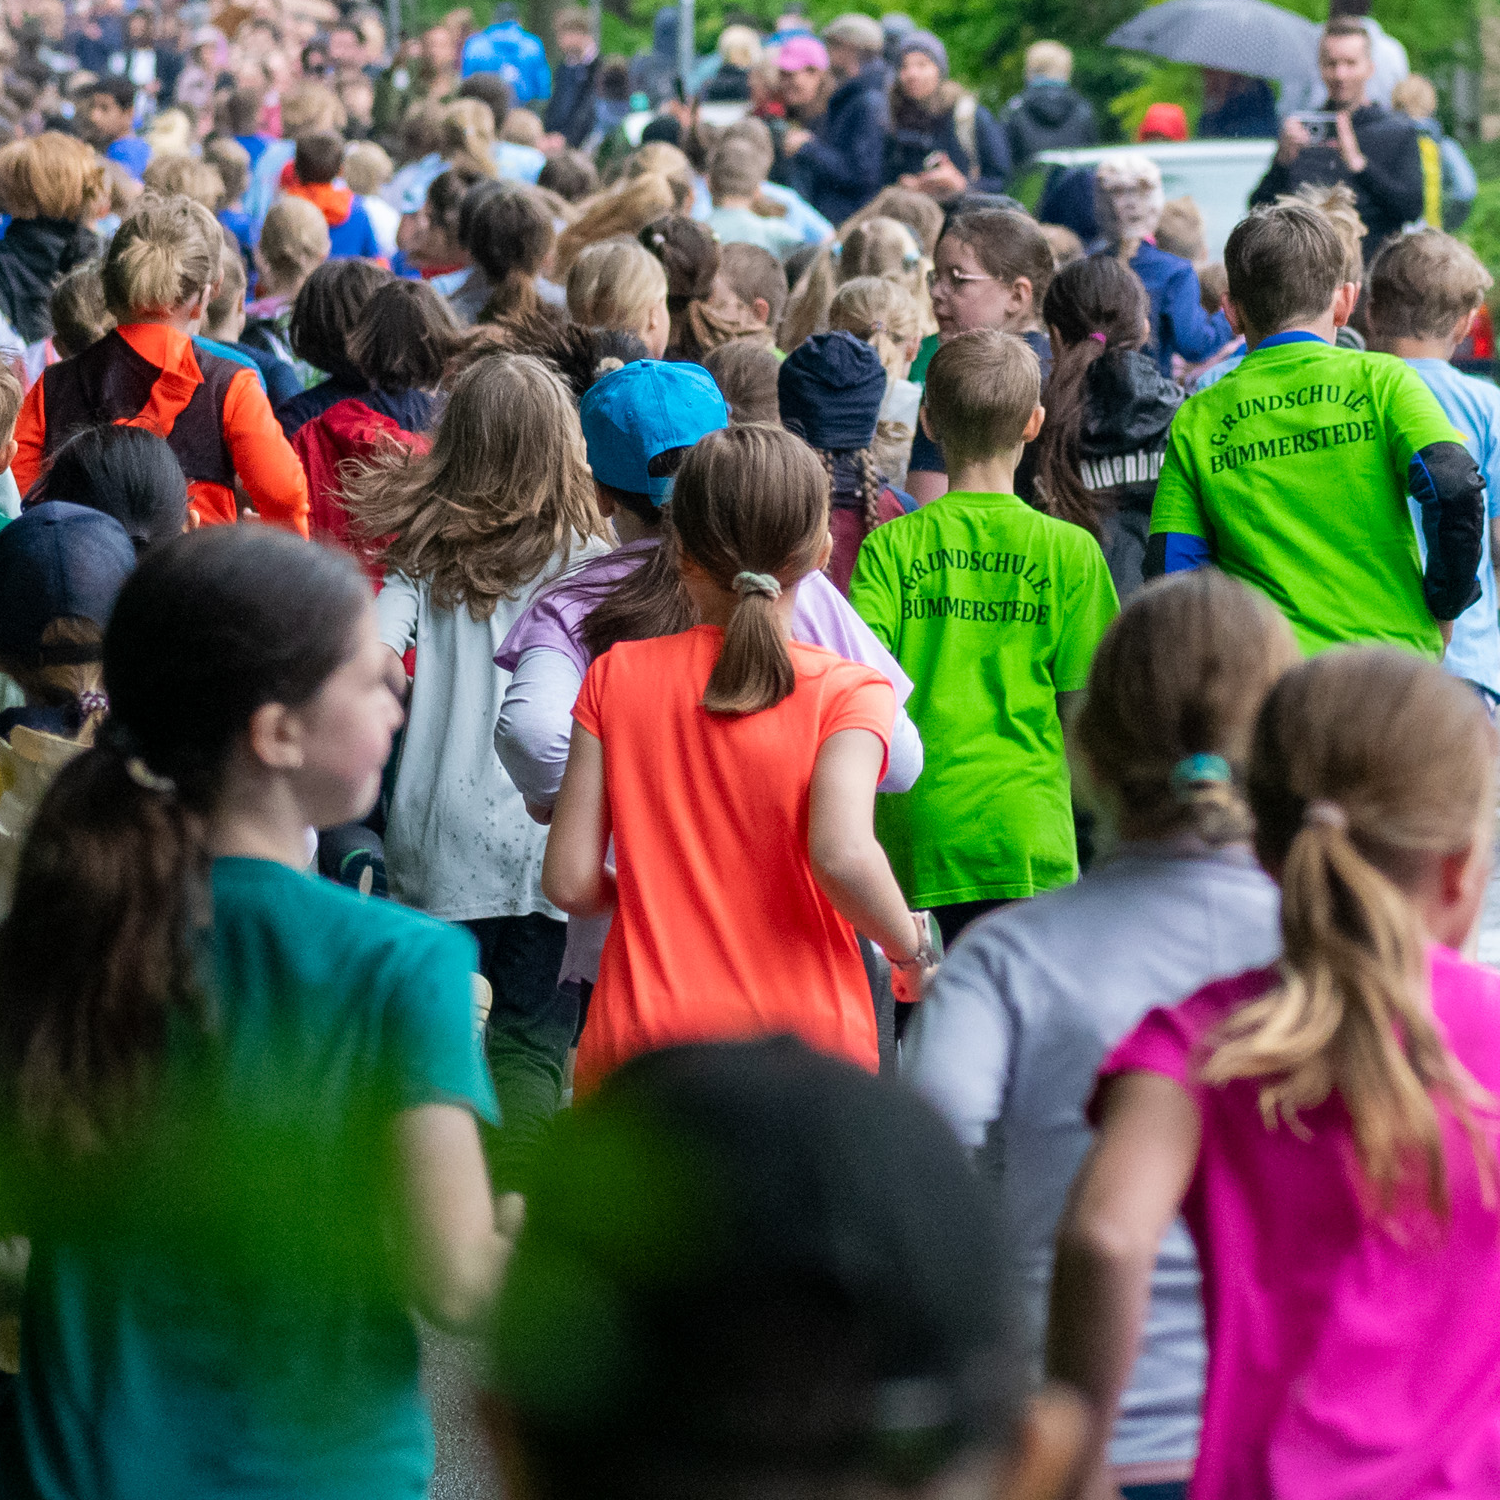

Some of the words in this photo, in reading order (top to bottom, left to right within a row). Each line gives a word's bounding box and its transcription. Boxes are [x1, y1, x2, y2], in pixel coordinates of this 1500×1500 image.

[1209, 384, 1371, 446] GRUNDSCHULE
[1209, 419, 1376, 474] BÜMMERSTEDE
[901, 548, 1052, 595] GRUNDSCHULE
[901, 593, 1050, 626] BÜMMERSTEDE
